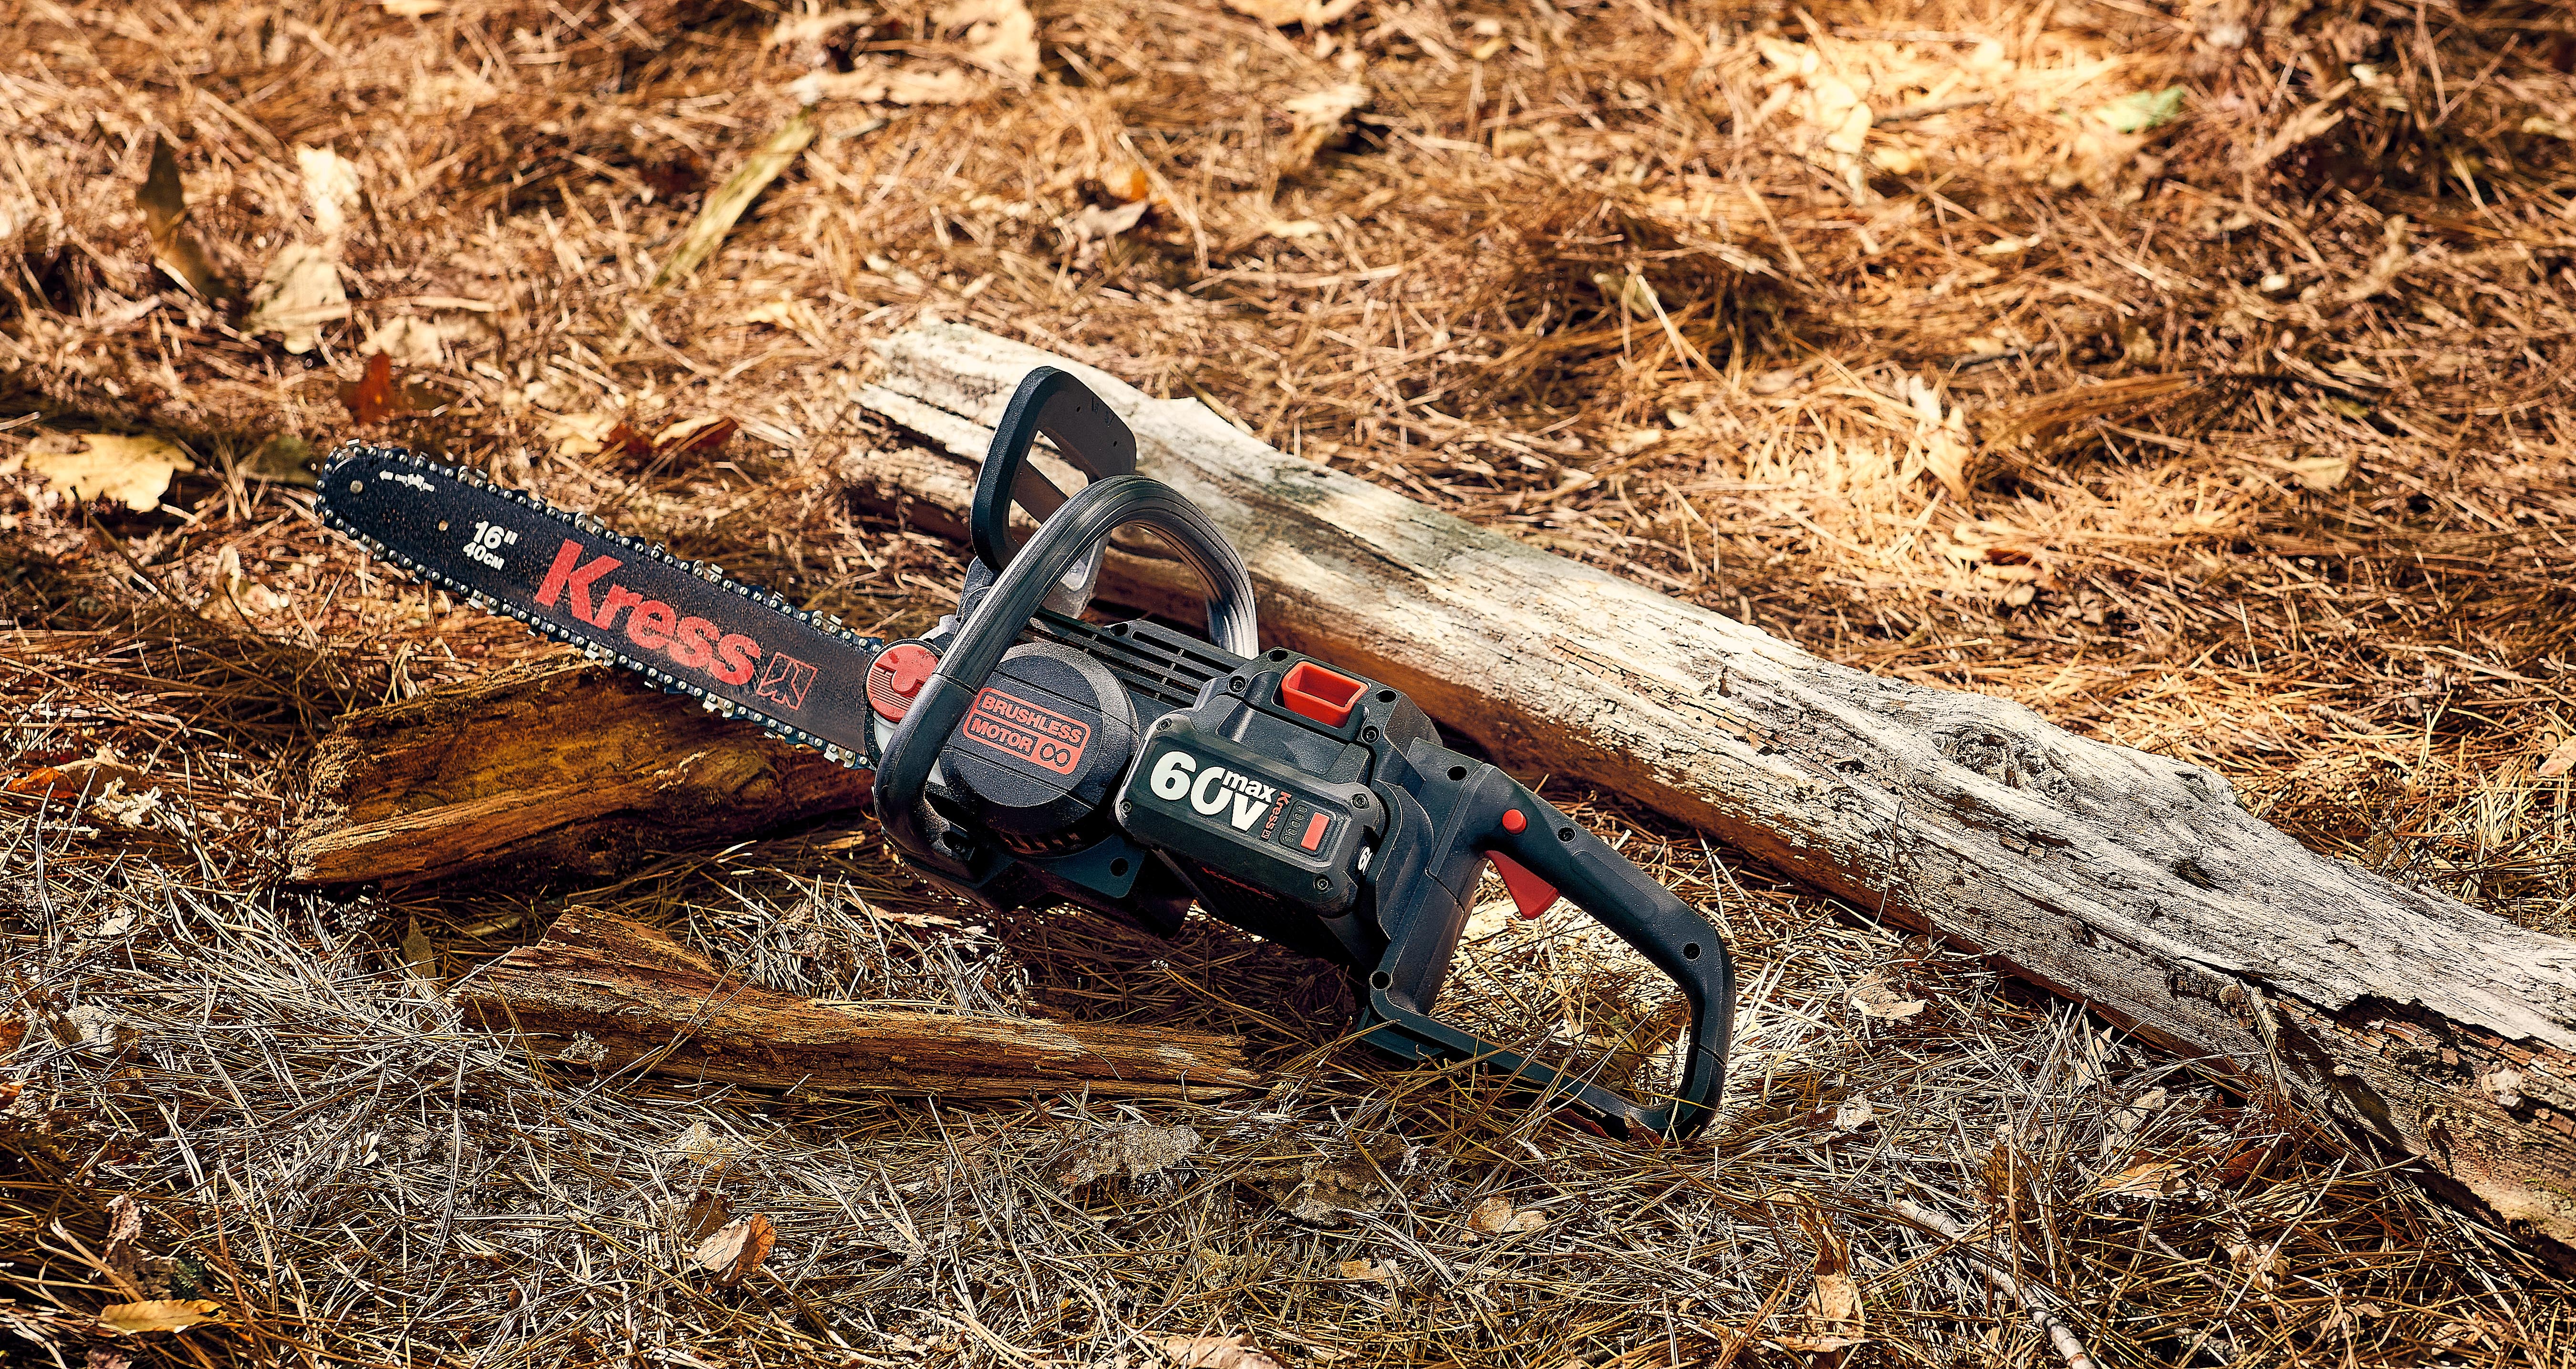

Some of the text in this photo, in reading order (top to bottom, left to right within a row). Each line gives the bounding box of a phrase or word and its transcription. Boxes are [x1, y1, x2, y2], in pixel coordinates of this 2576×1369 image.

[473, 520, 518, 549] 16"
[534, 538, 761, 686] Kress
[971, 718, 1034, 752] MOTOR
[981, 694, 1083, 743] BRUSHLESS
[1222, 770, 1278, 803] max
[1265, 791, 1292, 830] Kress
